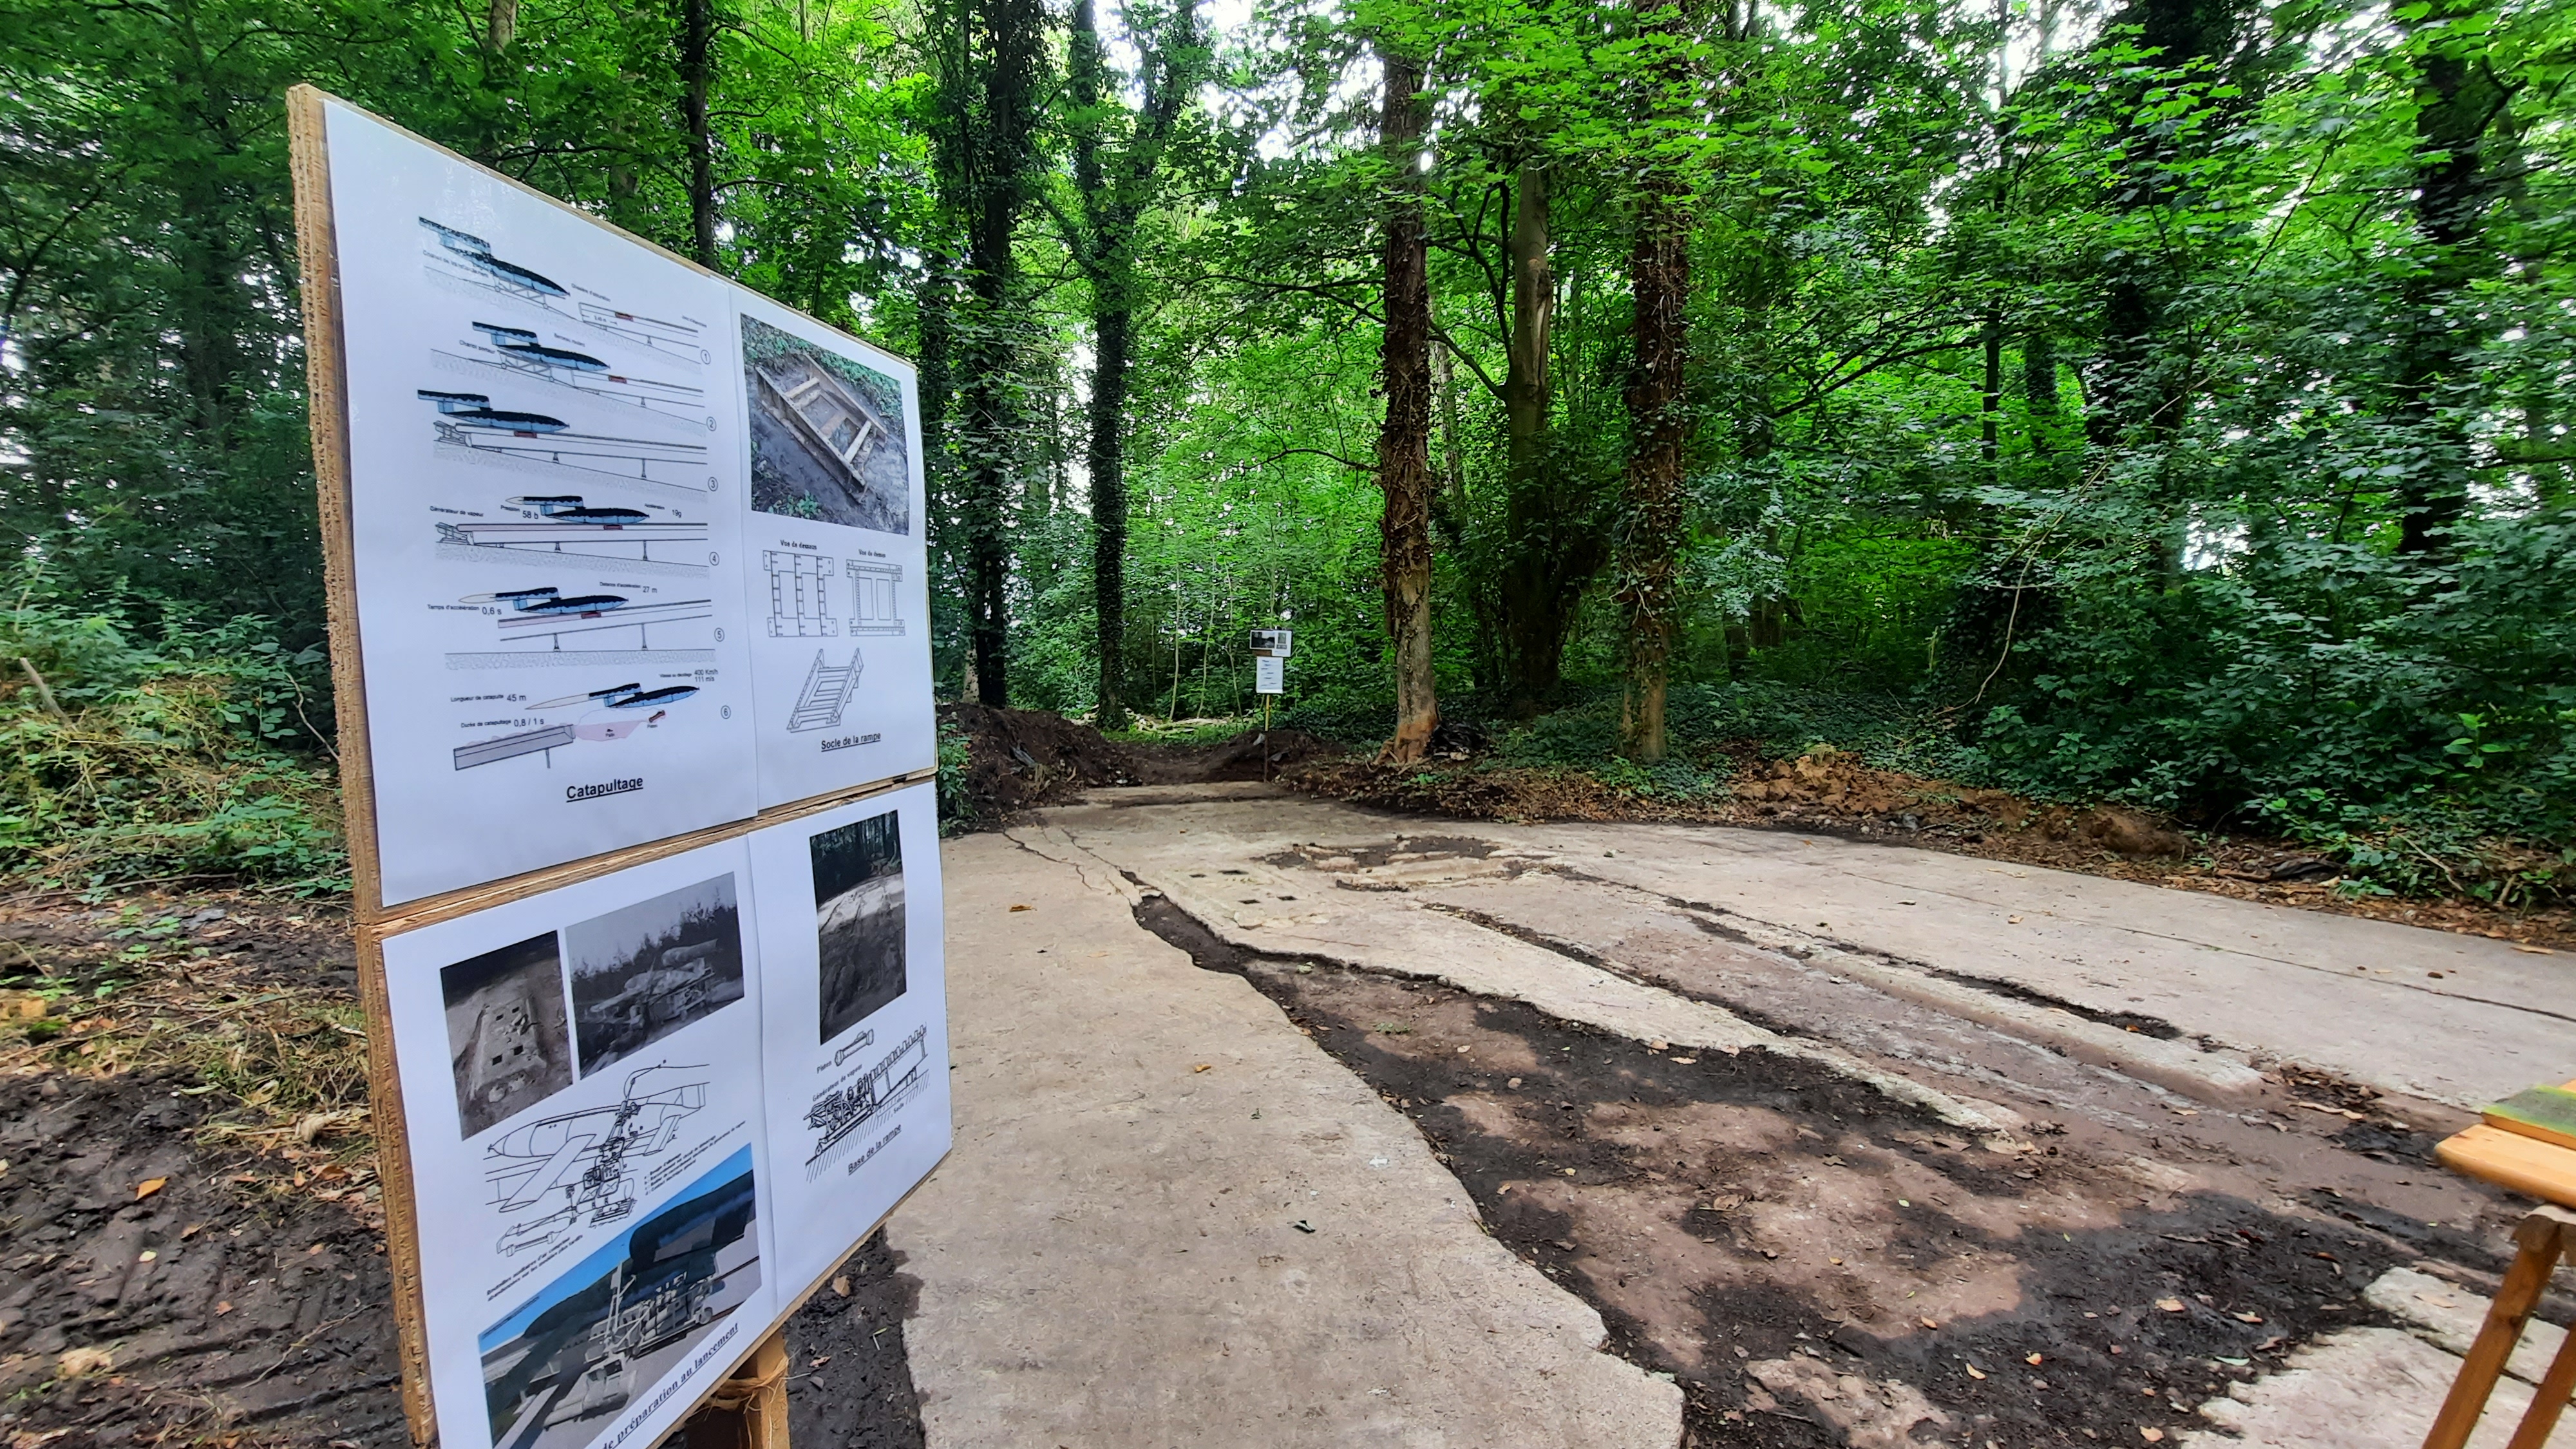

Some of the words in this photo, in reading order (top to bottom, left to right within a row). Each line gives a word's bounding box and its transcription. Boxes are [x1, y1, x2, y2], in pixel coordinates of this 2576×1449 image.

[522, 510, 532, 518] 58
[672, 509, 682, 518] 19g
[482, 607, 495, 616] 0,6
[514, 719, 527, 728] 0,8
[821, 738, 841, 750] Socle
[843, 736, 851, 746] de
[853, 735, 859, 743] la
[861, 733, 881, 743] rampe
[567, 777, 643, 799] Catapultage
[848, 1155, 865, 1173] Base
[866, 1147, 875, 1158] de
[875, 1141, 882, 1150] la
[882, 1124, 901, 1144] rampe
[617, 1381, 679, 1443] préparation
[681, 1367, 692, 1383] au
[695, 1322, 739, 1370] lancement
